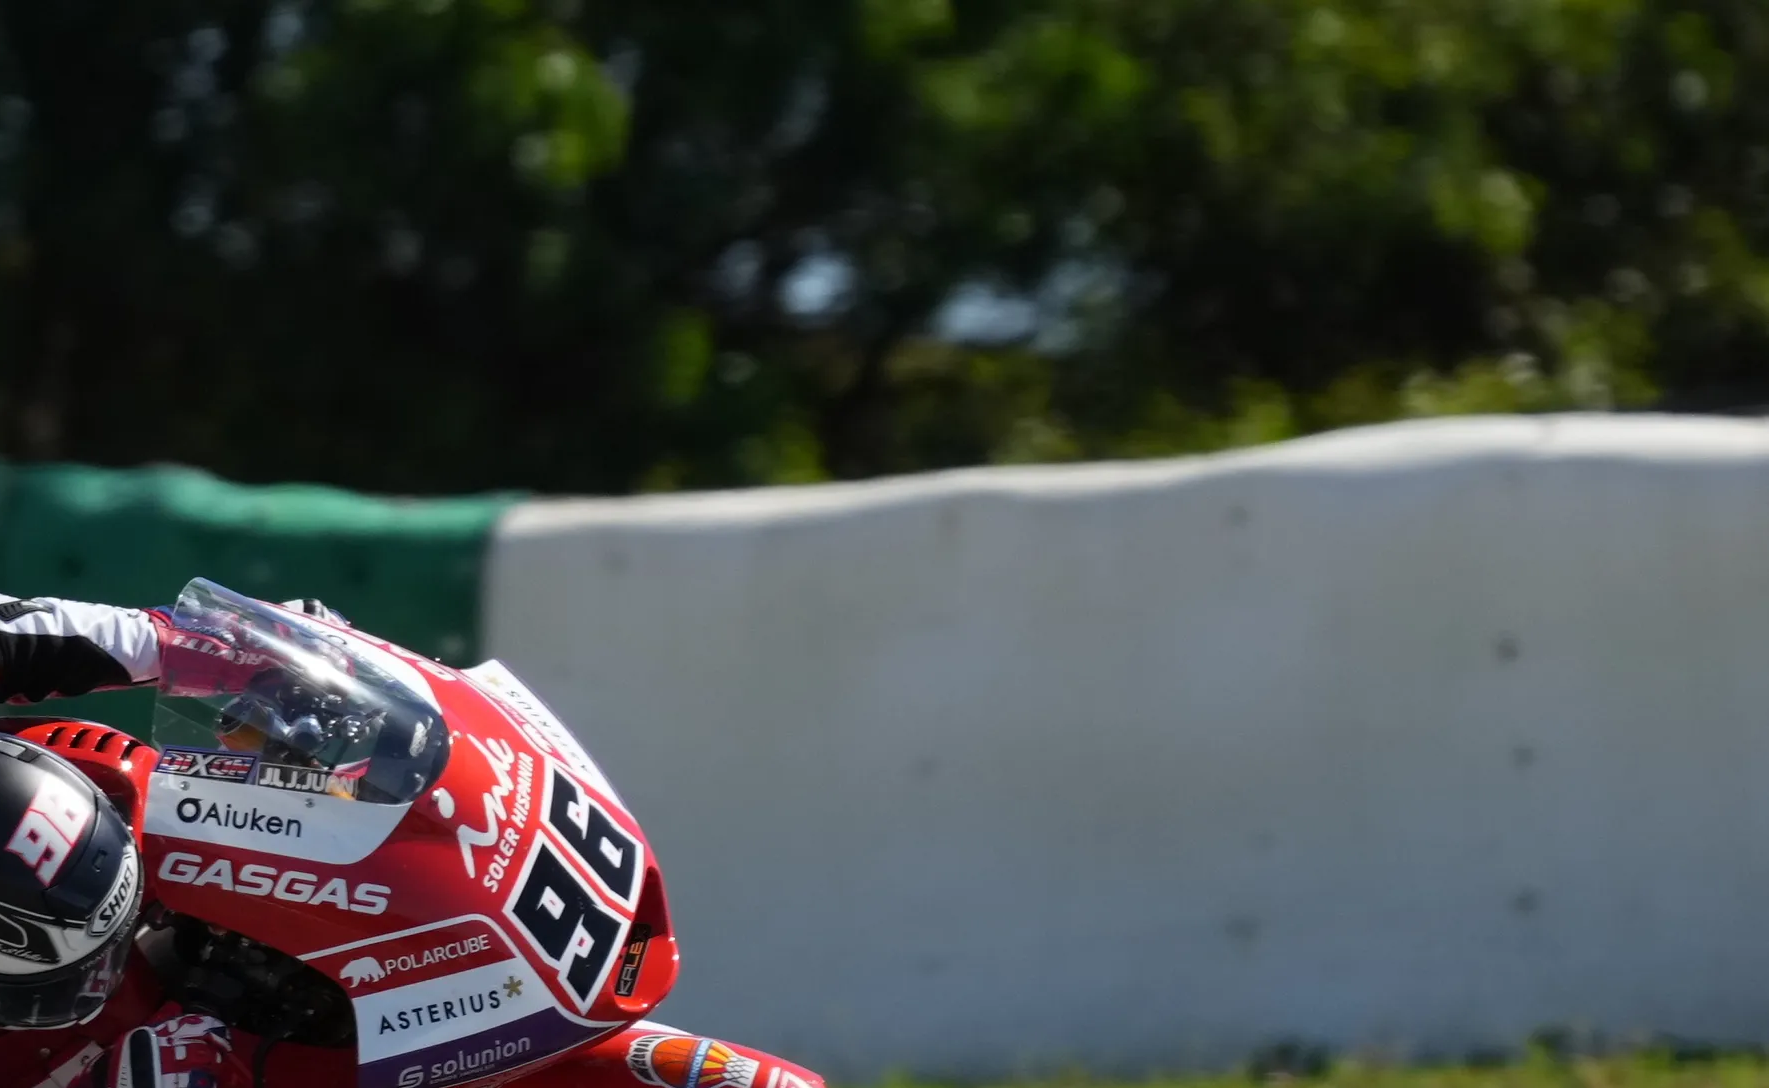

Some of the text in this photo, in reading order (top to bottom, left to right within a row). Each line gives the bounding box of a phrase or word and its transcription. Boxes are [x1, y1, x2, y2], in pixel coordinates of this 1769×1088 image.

[158, 752, 253, 778] DIXON
[5, 774, 91, 888] 96
[201, 803, 302, 838] Aiuken
[483, 751, 534, 893] SOLER HISPANIA
[158, 852, 391, 915] GASGAS
[507, 762, 641, 1008] 96
[385, 934, 491, 975] POLARCUBE
[379, 990, 502, 1035] ASTERIUS
[431, 1037, 530, 1078] solunion
